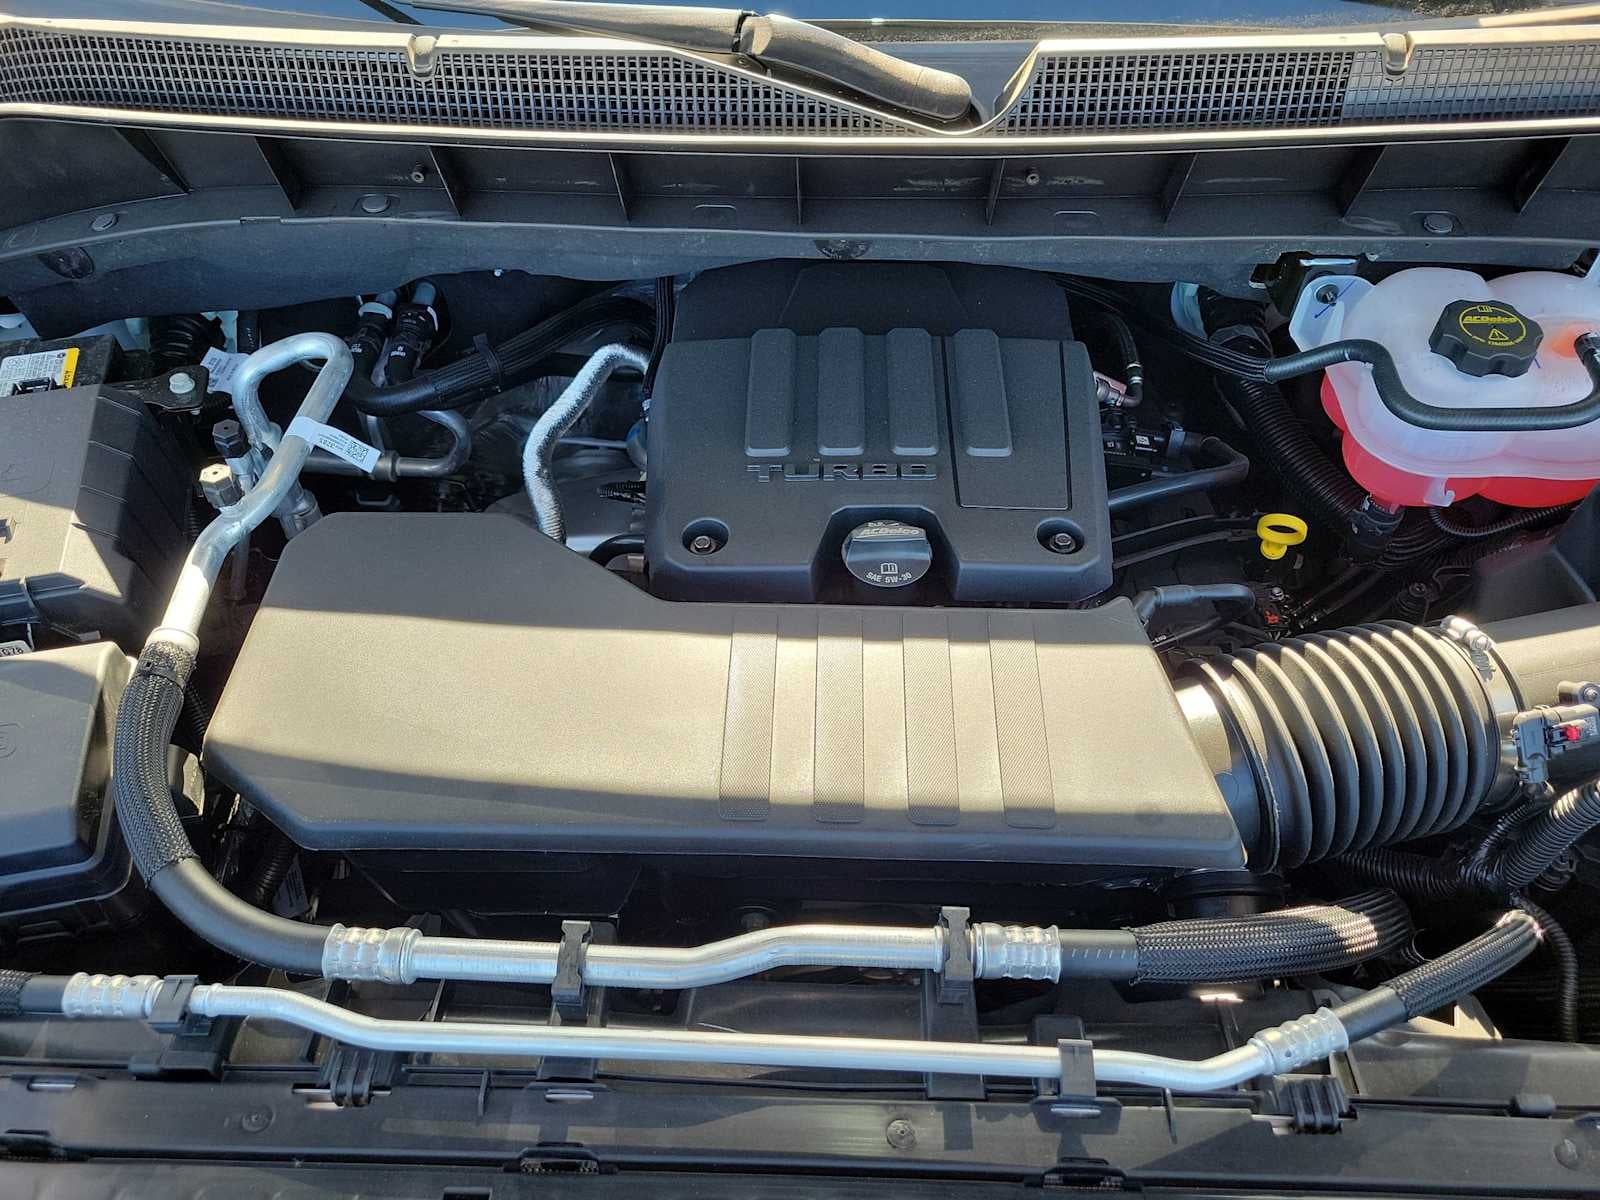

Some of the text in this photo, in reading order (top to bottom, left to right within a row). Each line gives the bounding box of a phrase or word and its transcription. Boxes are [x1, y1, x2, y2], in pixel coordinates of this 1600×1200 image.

[746, 463, 937, 483] TURBO
[857, 527, 920, 537] ACDelco
[866, 571, 912, 583] SAE 5W-30
